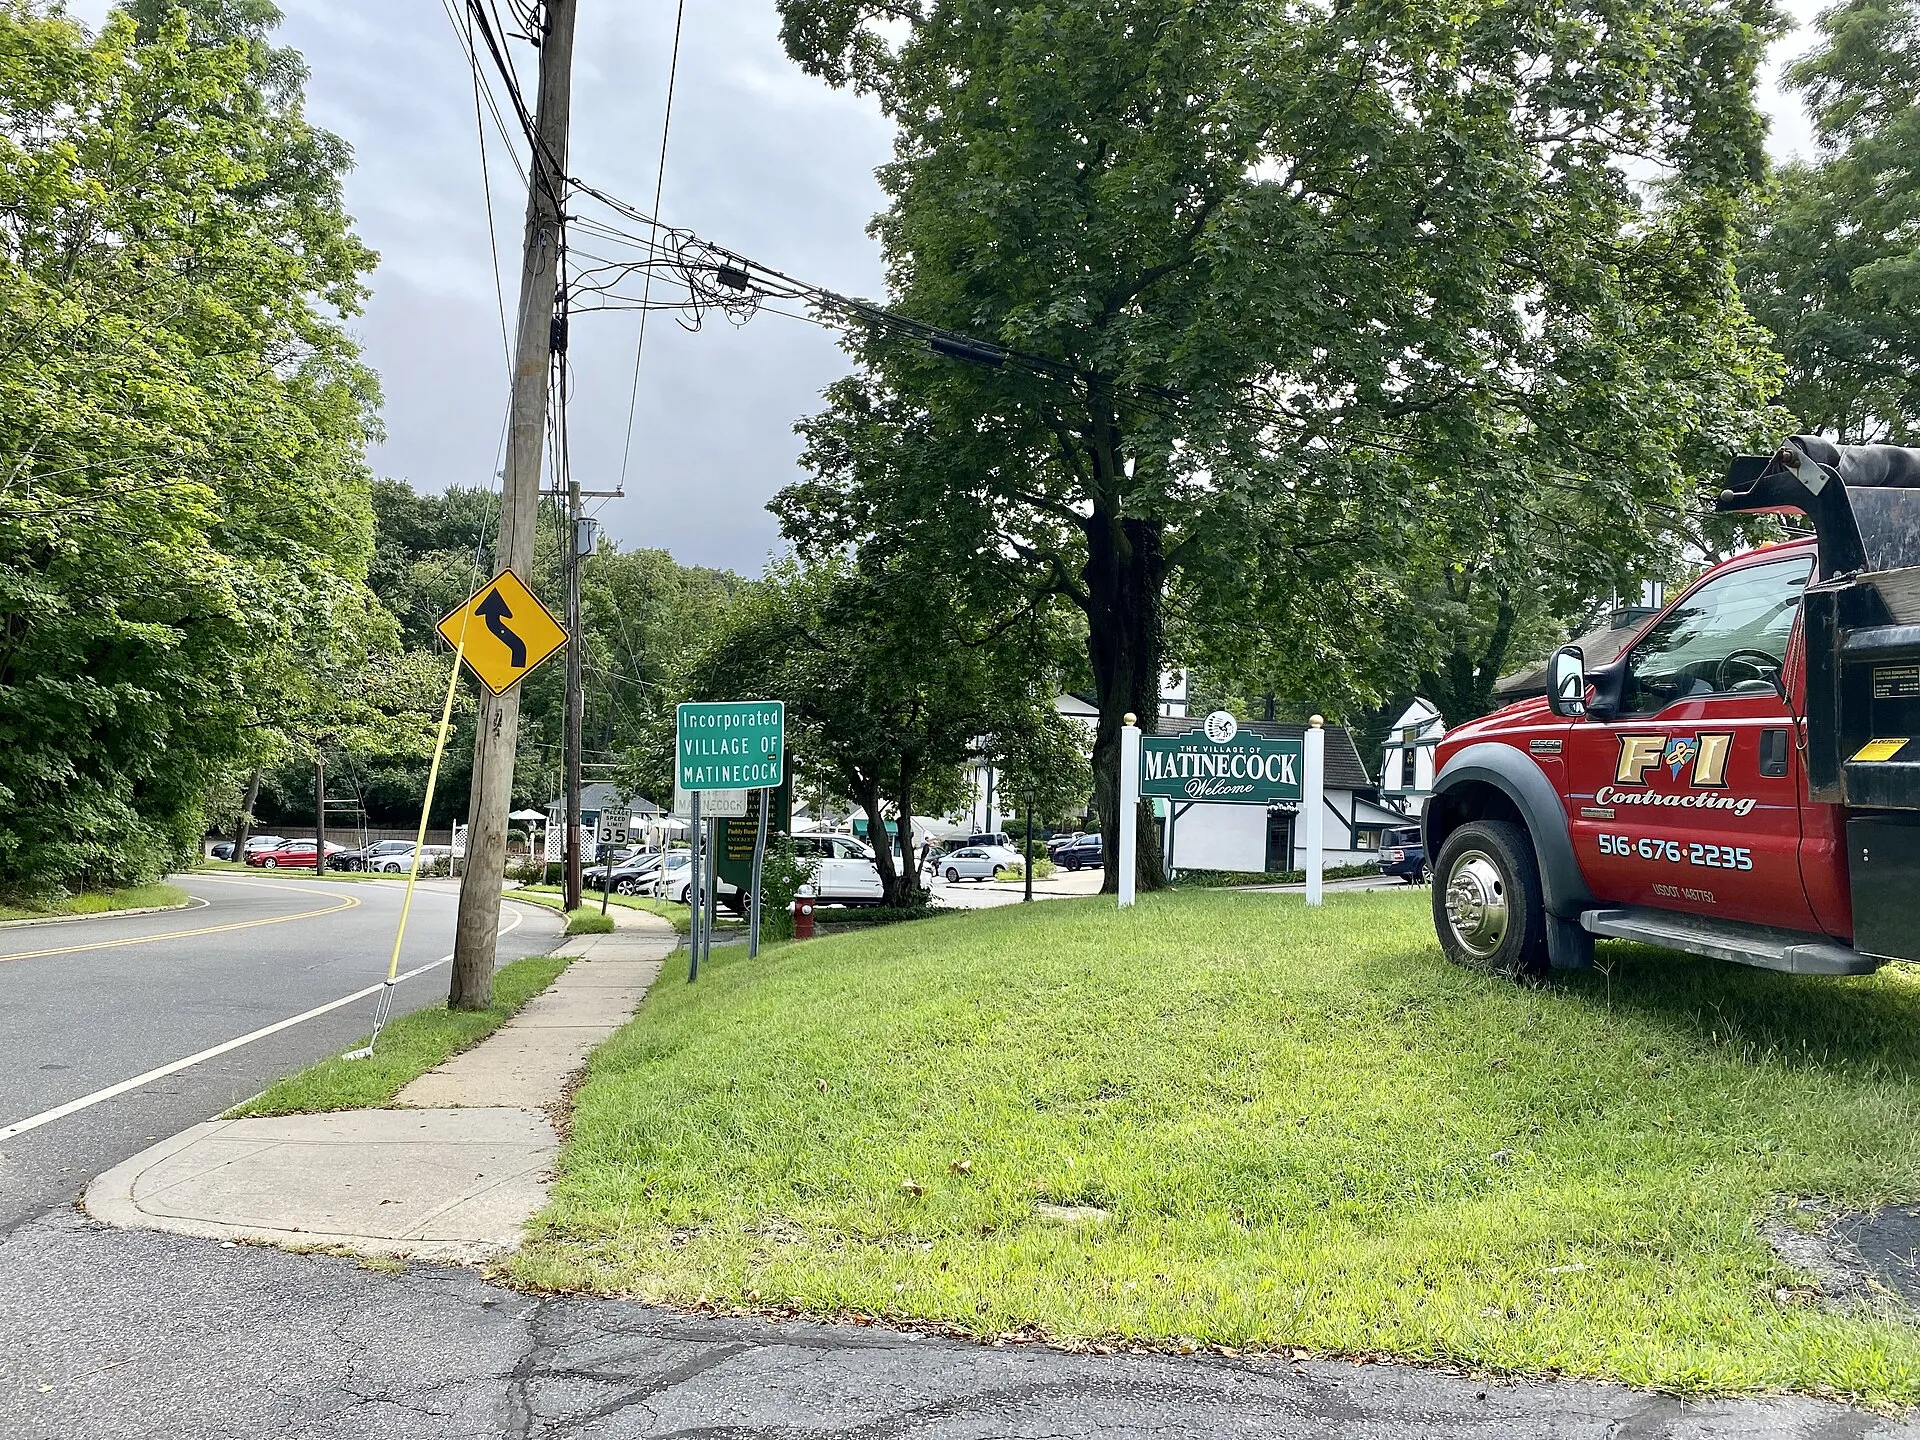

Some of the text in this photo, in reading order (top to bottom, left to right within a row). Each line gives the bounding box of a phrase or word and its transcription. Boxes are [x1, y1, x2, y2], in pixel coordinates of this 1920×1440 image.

[683, 709, 778, 731] Incorporated
[684, 736, 778, 755] VILLAGE OF
[1203, 745, 1244, 753] VILLAGE
[1144, 750, 1298, 786] MATINECOCK
[1613, 732, 1671, 787] F
[1689, 731, 1736, 789] I
[683, 762, 778, 783] MATINECOCK
[1184, 777, 1255, 798] Welcome
[1595, 786, 1757, 816] Contracting
[601, 828, 626, 843] 35
[1652, 883, 1680, 899] USDOT
